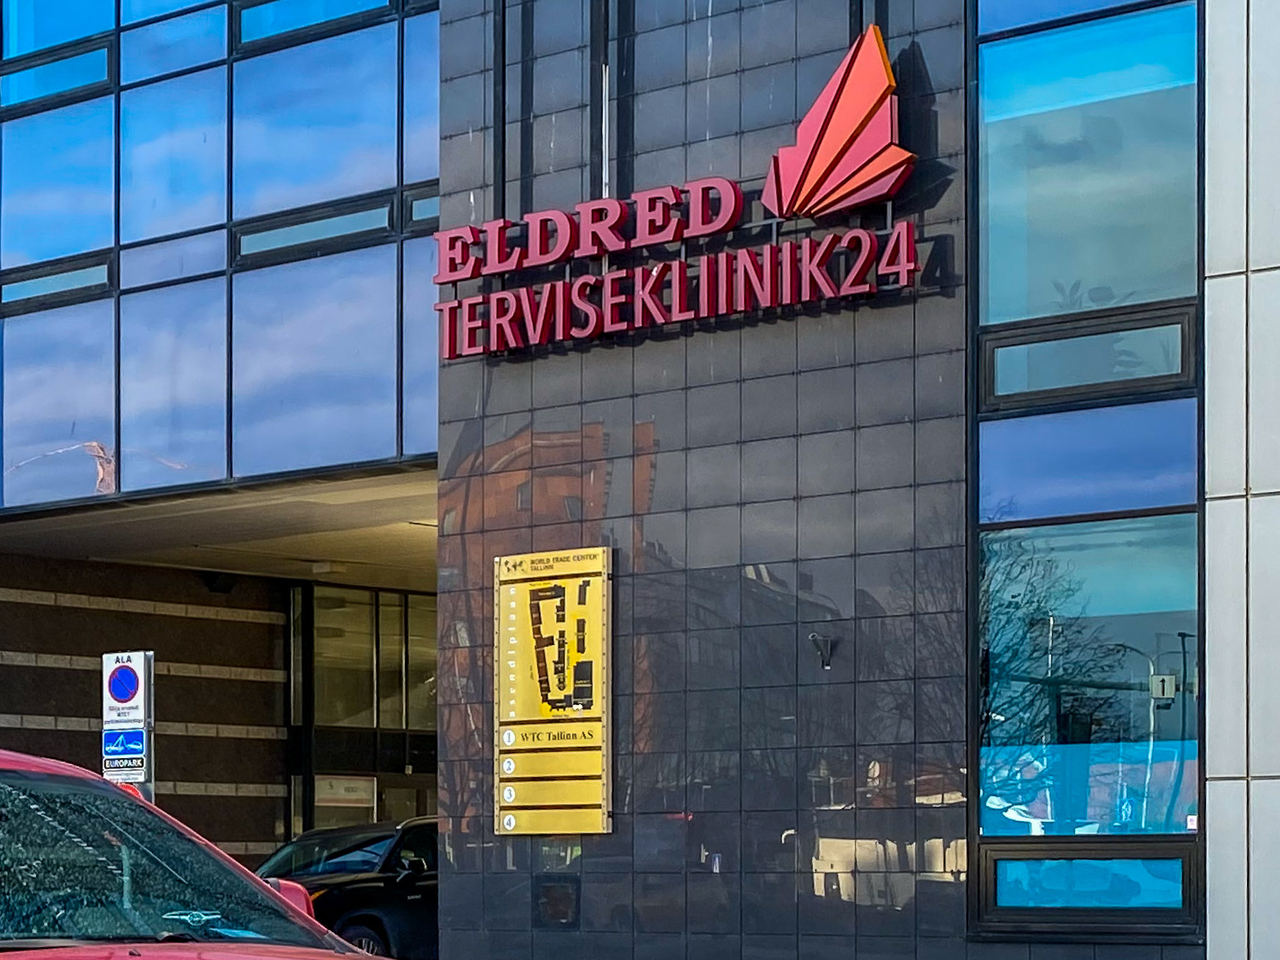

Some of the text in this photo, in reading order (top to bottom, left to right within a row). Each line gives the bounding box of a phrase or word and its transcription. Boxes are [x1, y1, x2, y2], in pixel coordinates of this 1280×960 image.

[433, 177, 743, 284] ELDRED
[434, 221, 919, 360] TERVISEKLIINIK24
[530, 557, 550, 566] WORLD
[552, 555, 571, 564] TRADE
[530, 564, 554, 572] TALLINN
[114, 655, 132, 664] ALA
[521, 731, 543, 743] WTC
[546, 731, 578, 742] Tallinn
[580, 730, 594, 740] AS
[105, 759, 143, 768] EUROPARK
